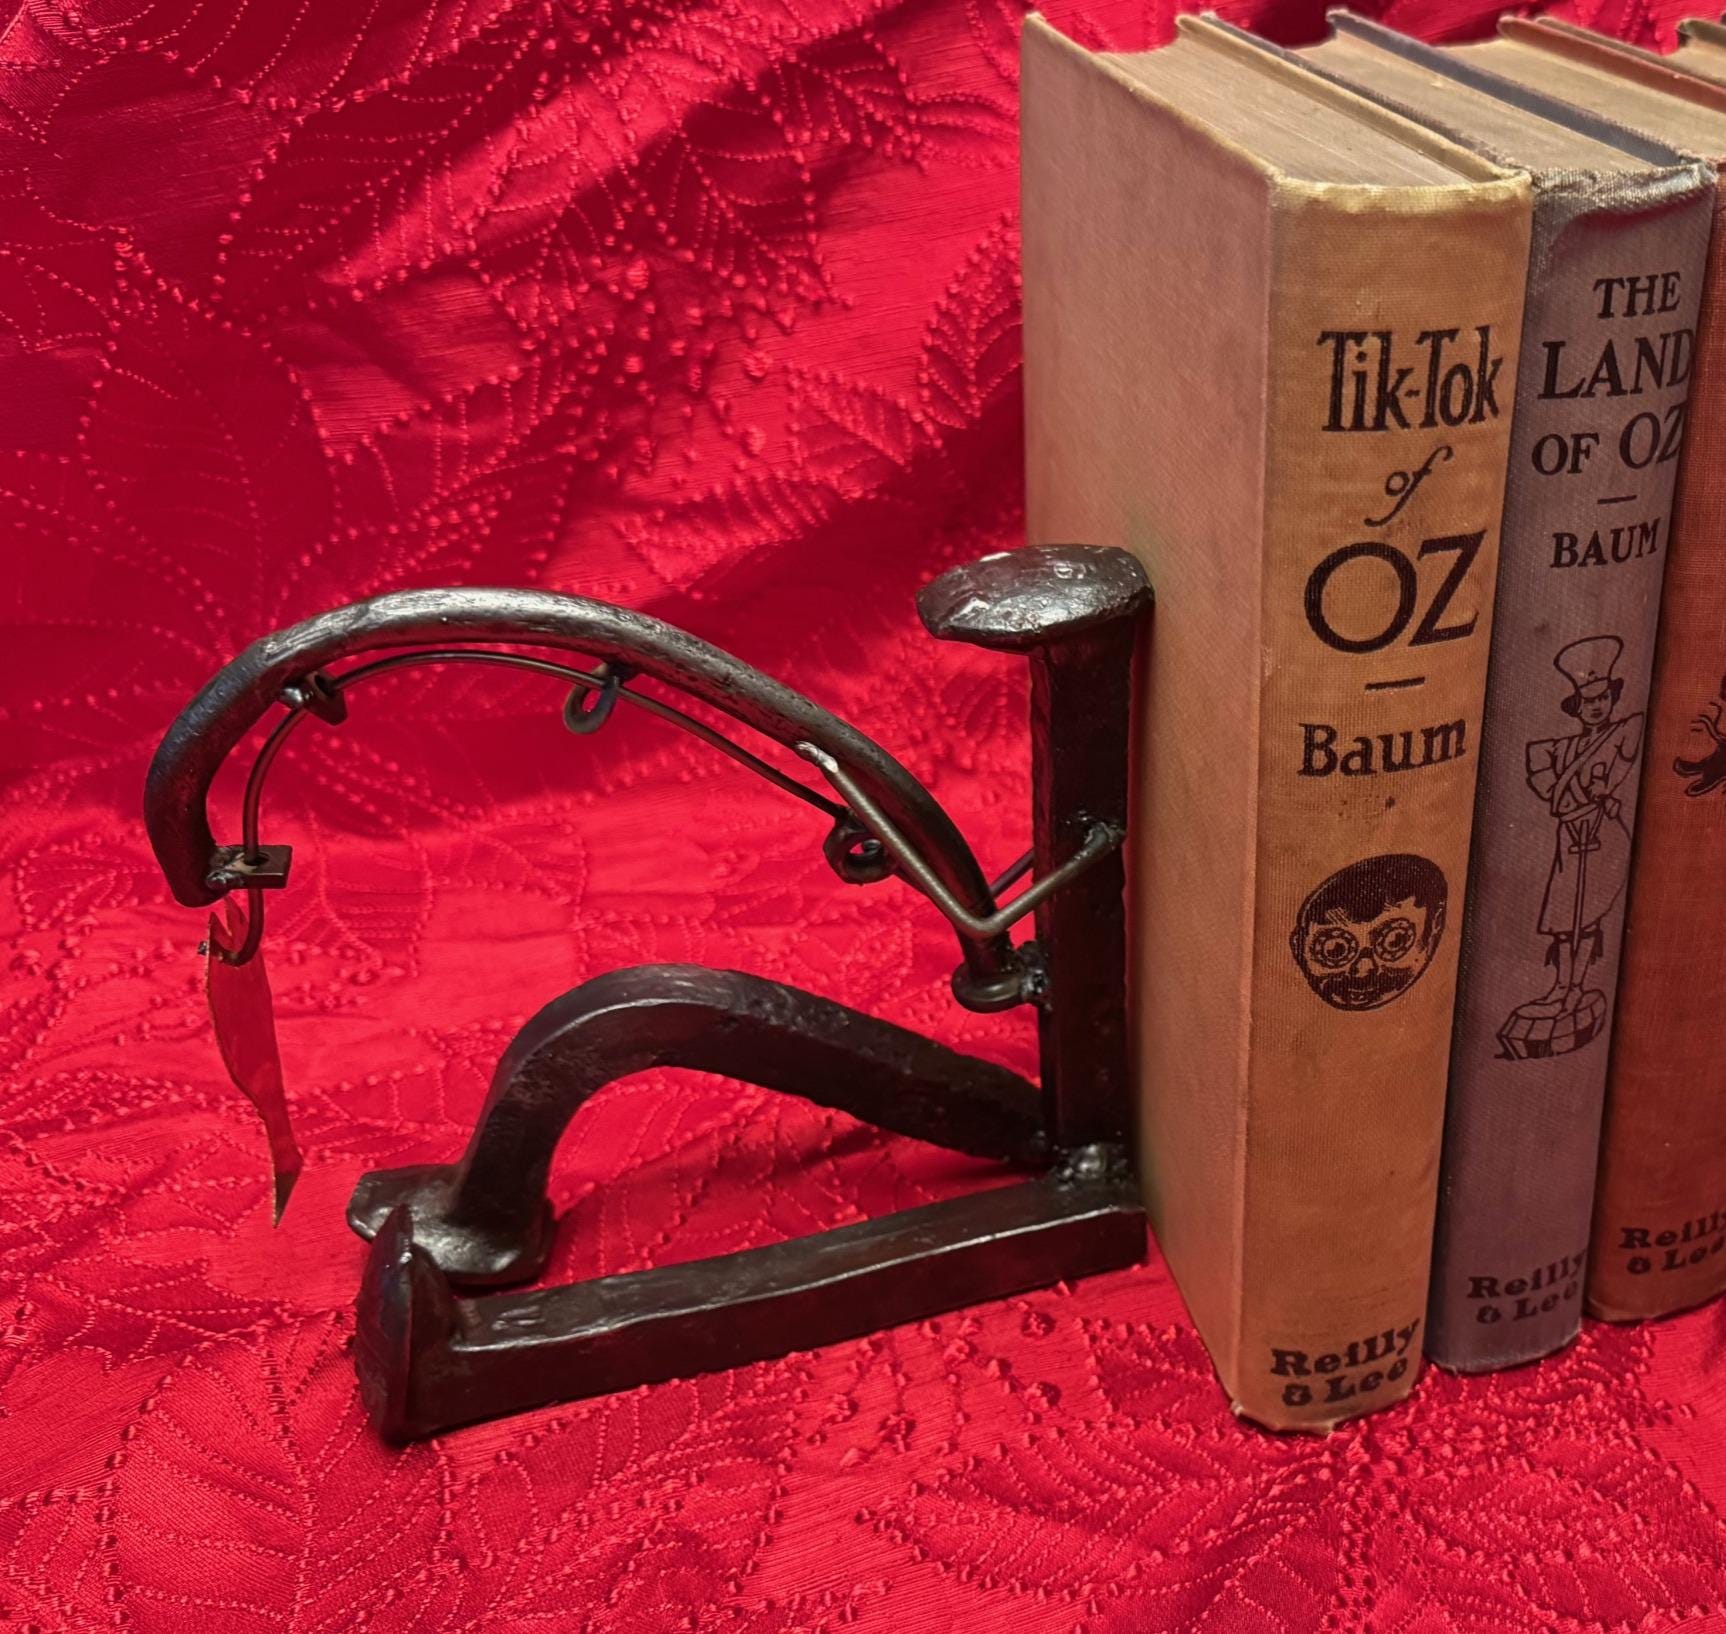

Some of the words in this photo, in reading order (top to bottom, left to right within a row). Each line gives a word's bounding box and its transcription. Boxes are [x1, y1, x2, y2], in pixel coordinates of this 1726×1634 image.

[1593, 271, 1681, 320] THE
[1316, 325, 1503, 432] Tik-Tok
[1537, 328, 1695, 400] LAND
[1531, 432, 1600, 476] OF
[1619, 400, 1689, 470] OZ
[1363, 445, 1454, 528] of
[1549, 517, 1662, 569] BAUM
[1303, 528, 1487, 654] OZ
[1297, 717, 1467, 778] Baum
[1465, 1248, 1586, 1299] Reilly
[1476, 1304, 1502, 1325] &
[1512, 1279, 1579, 1322] Lee
[1270, 1317, 1421, 1377] Reilly
[1281, 1382, 1313, 1407] &
[1323, 1357, 1408, 1404] Lee
